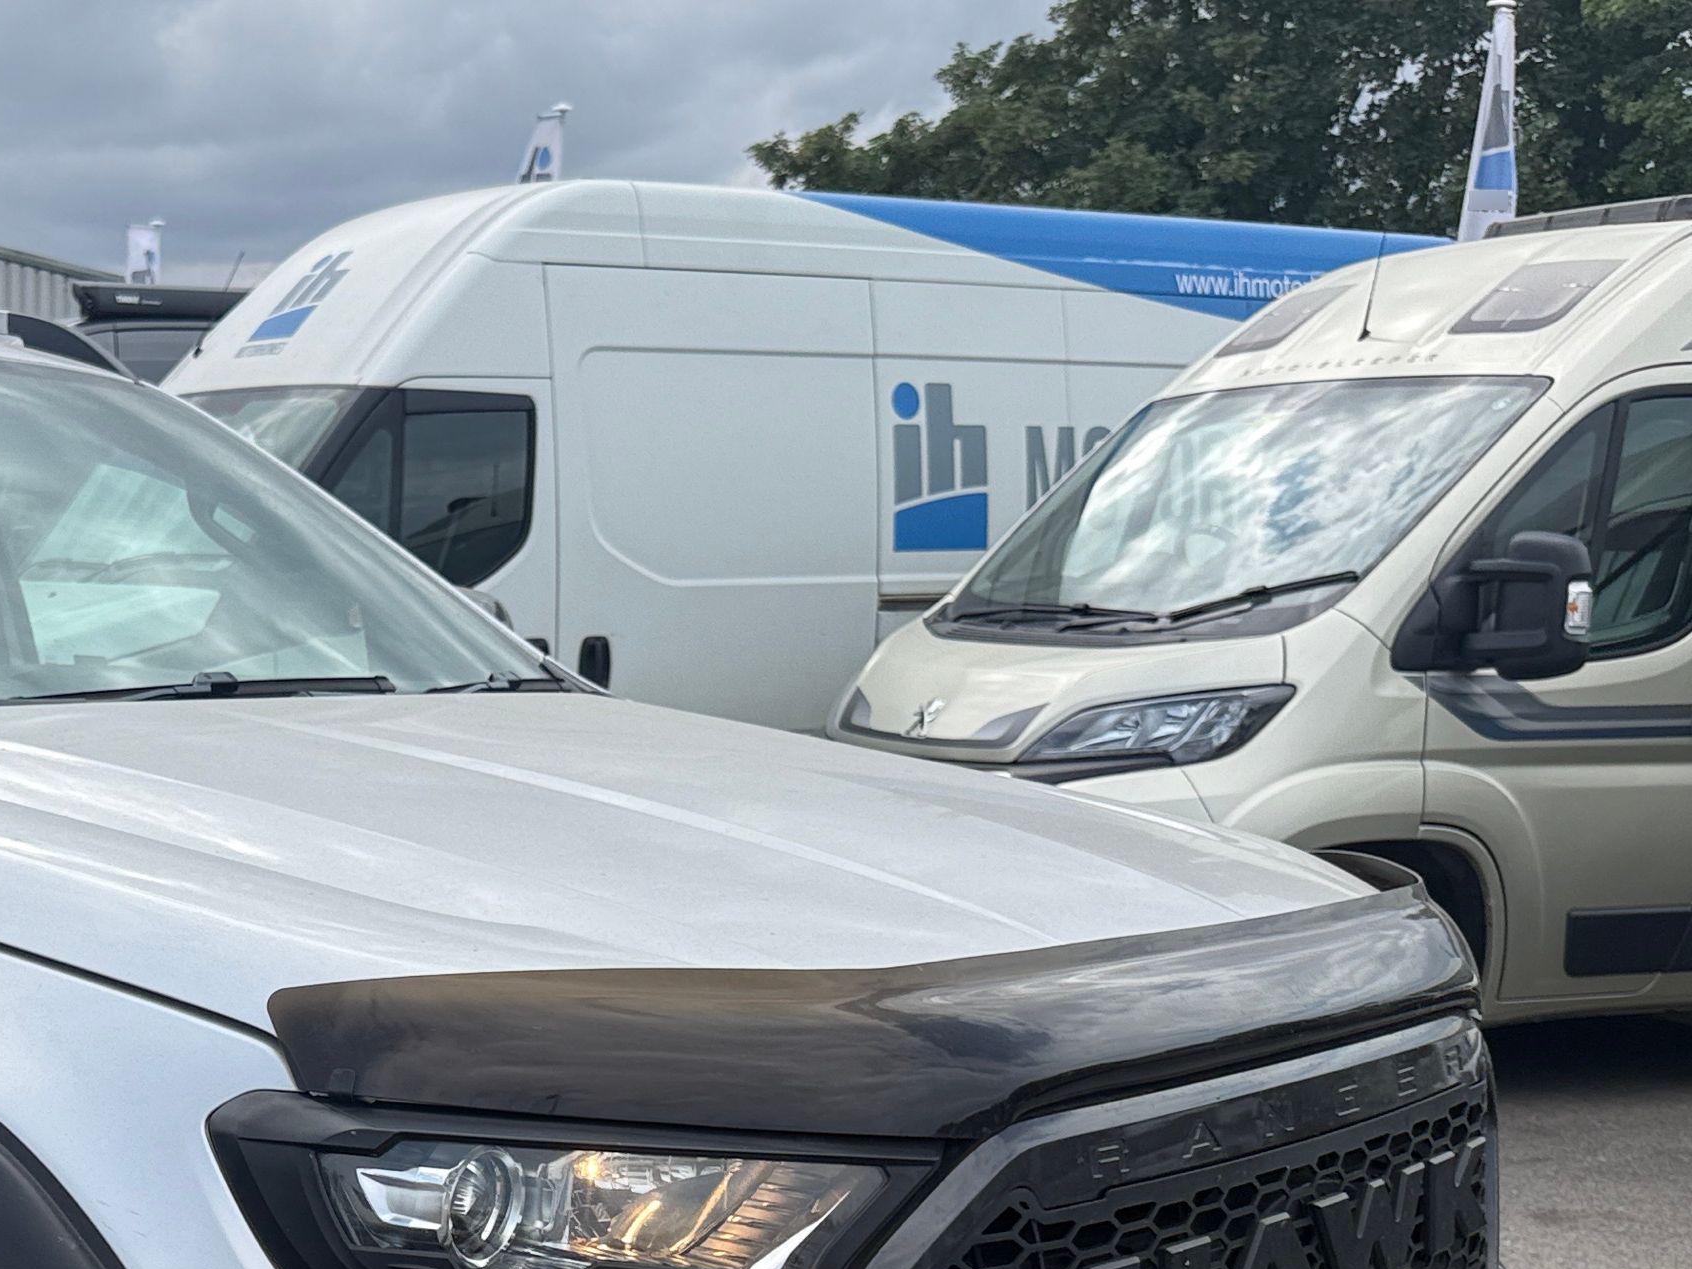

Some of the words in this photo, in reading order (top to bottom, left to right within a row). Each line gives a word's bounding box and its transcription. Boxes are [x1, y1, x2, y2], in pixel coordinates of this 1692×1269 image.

[1174, 271, 1316, 299] www.ihmoto
[892, 382, 988, 506] ih
[1092, 1043, 1471, 1179] RANGER
